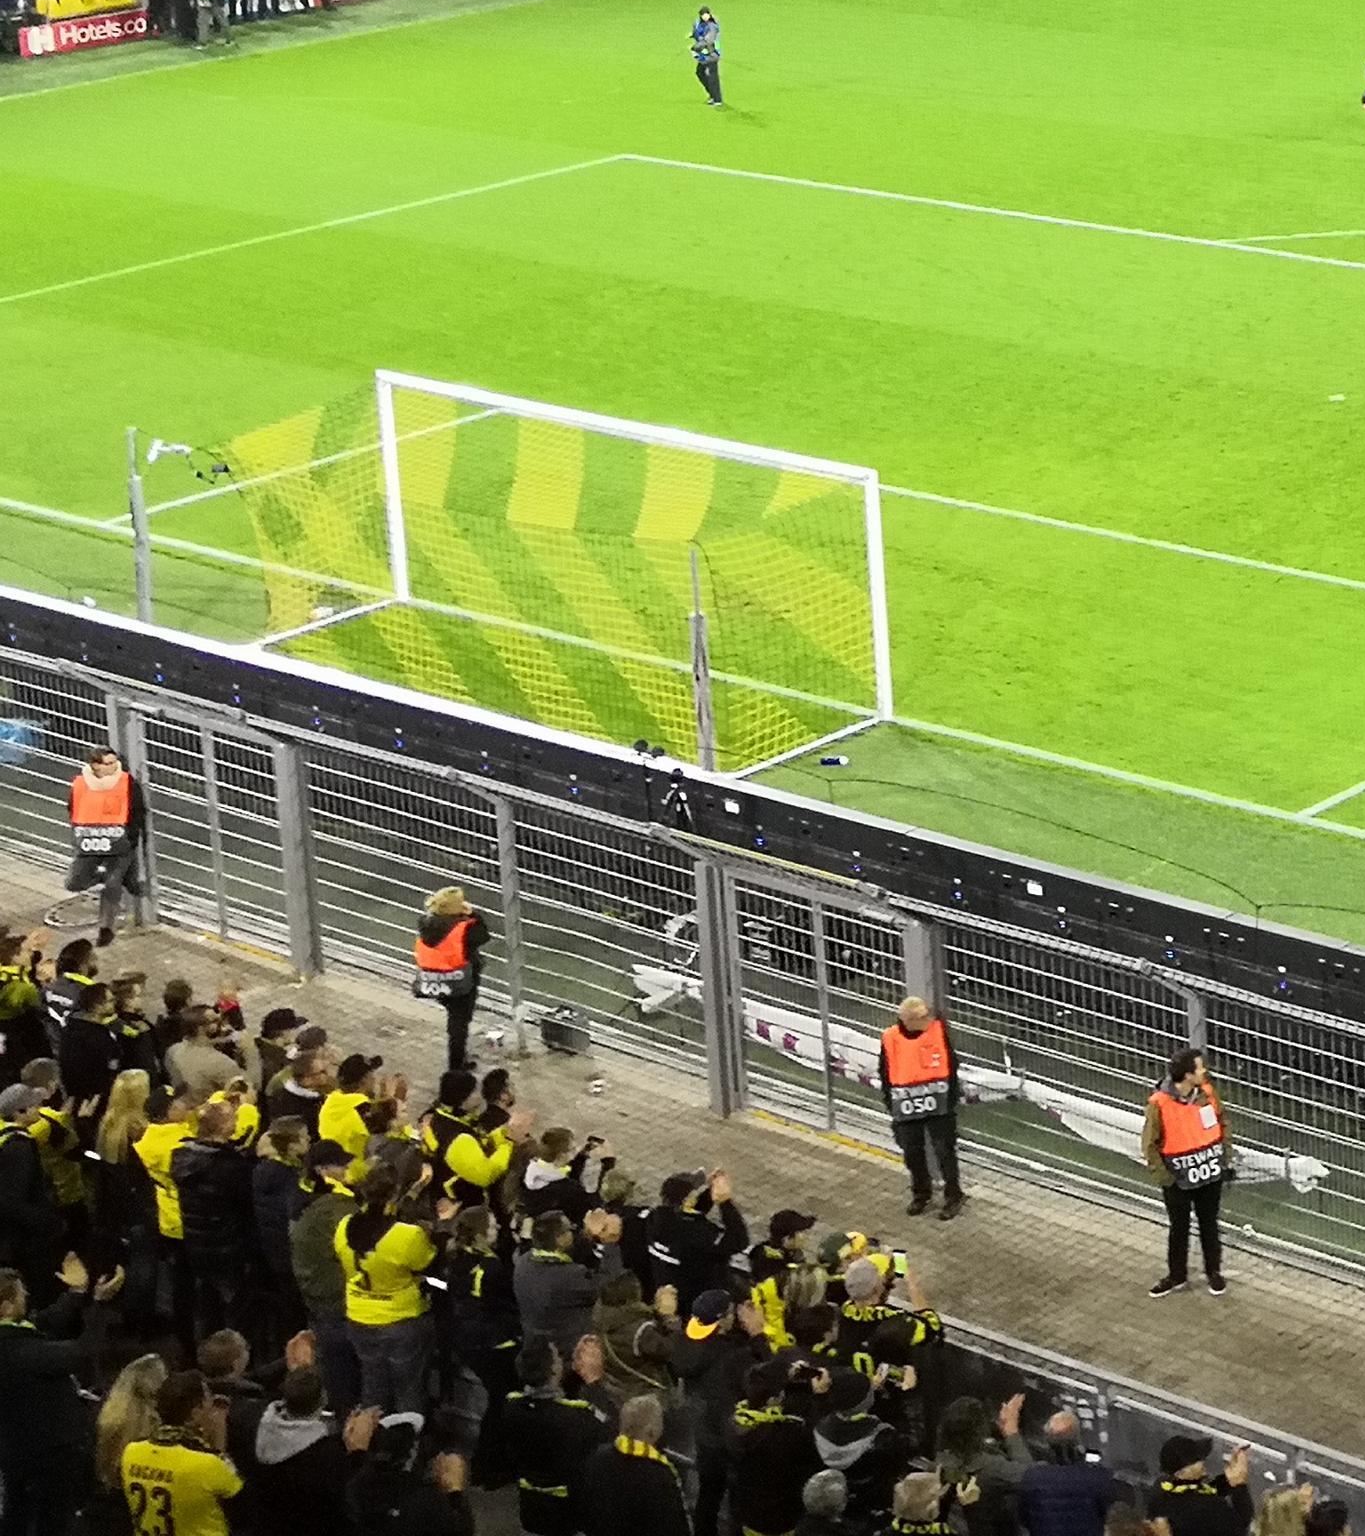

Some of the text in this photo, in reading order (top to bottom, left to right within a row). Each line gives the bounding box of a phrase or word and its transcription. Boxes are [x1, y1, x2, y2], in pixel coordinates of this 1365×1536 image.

[59, 16, 148, 46] Hotels.co
[901, 1096, 937, 1115] 050
[1171, 1143, 1224, 1170] STEWAR
[1188, 1158, 1221, 1183] 005
[129, 1481, 175, 1536] 23
